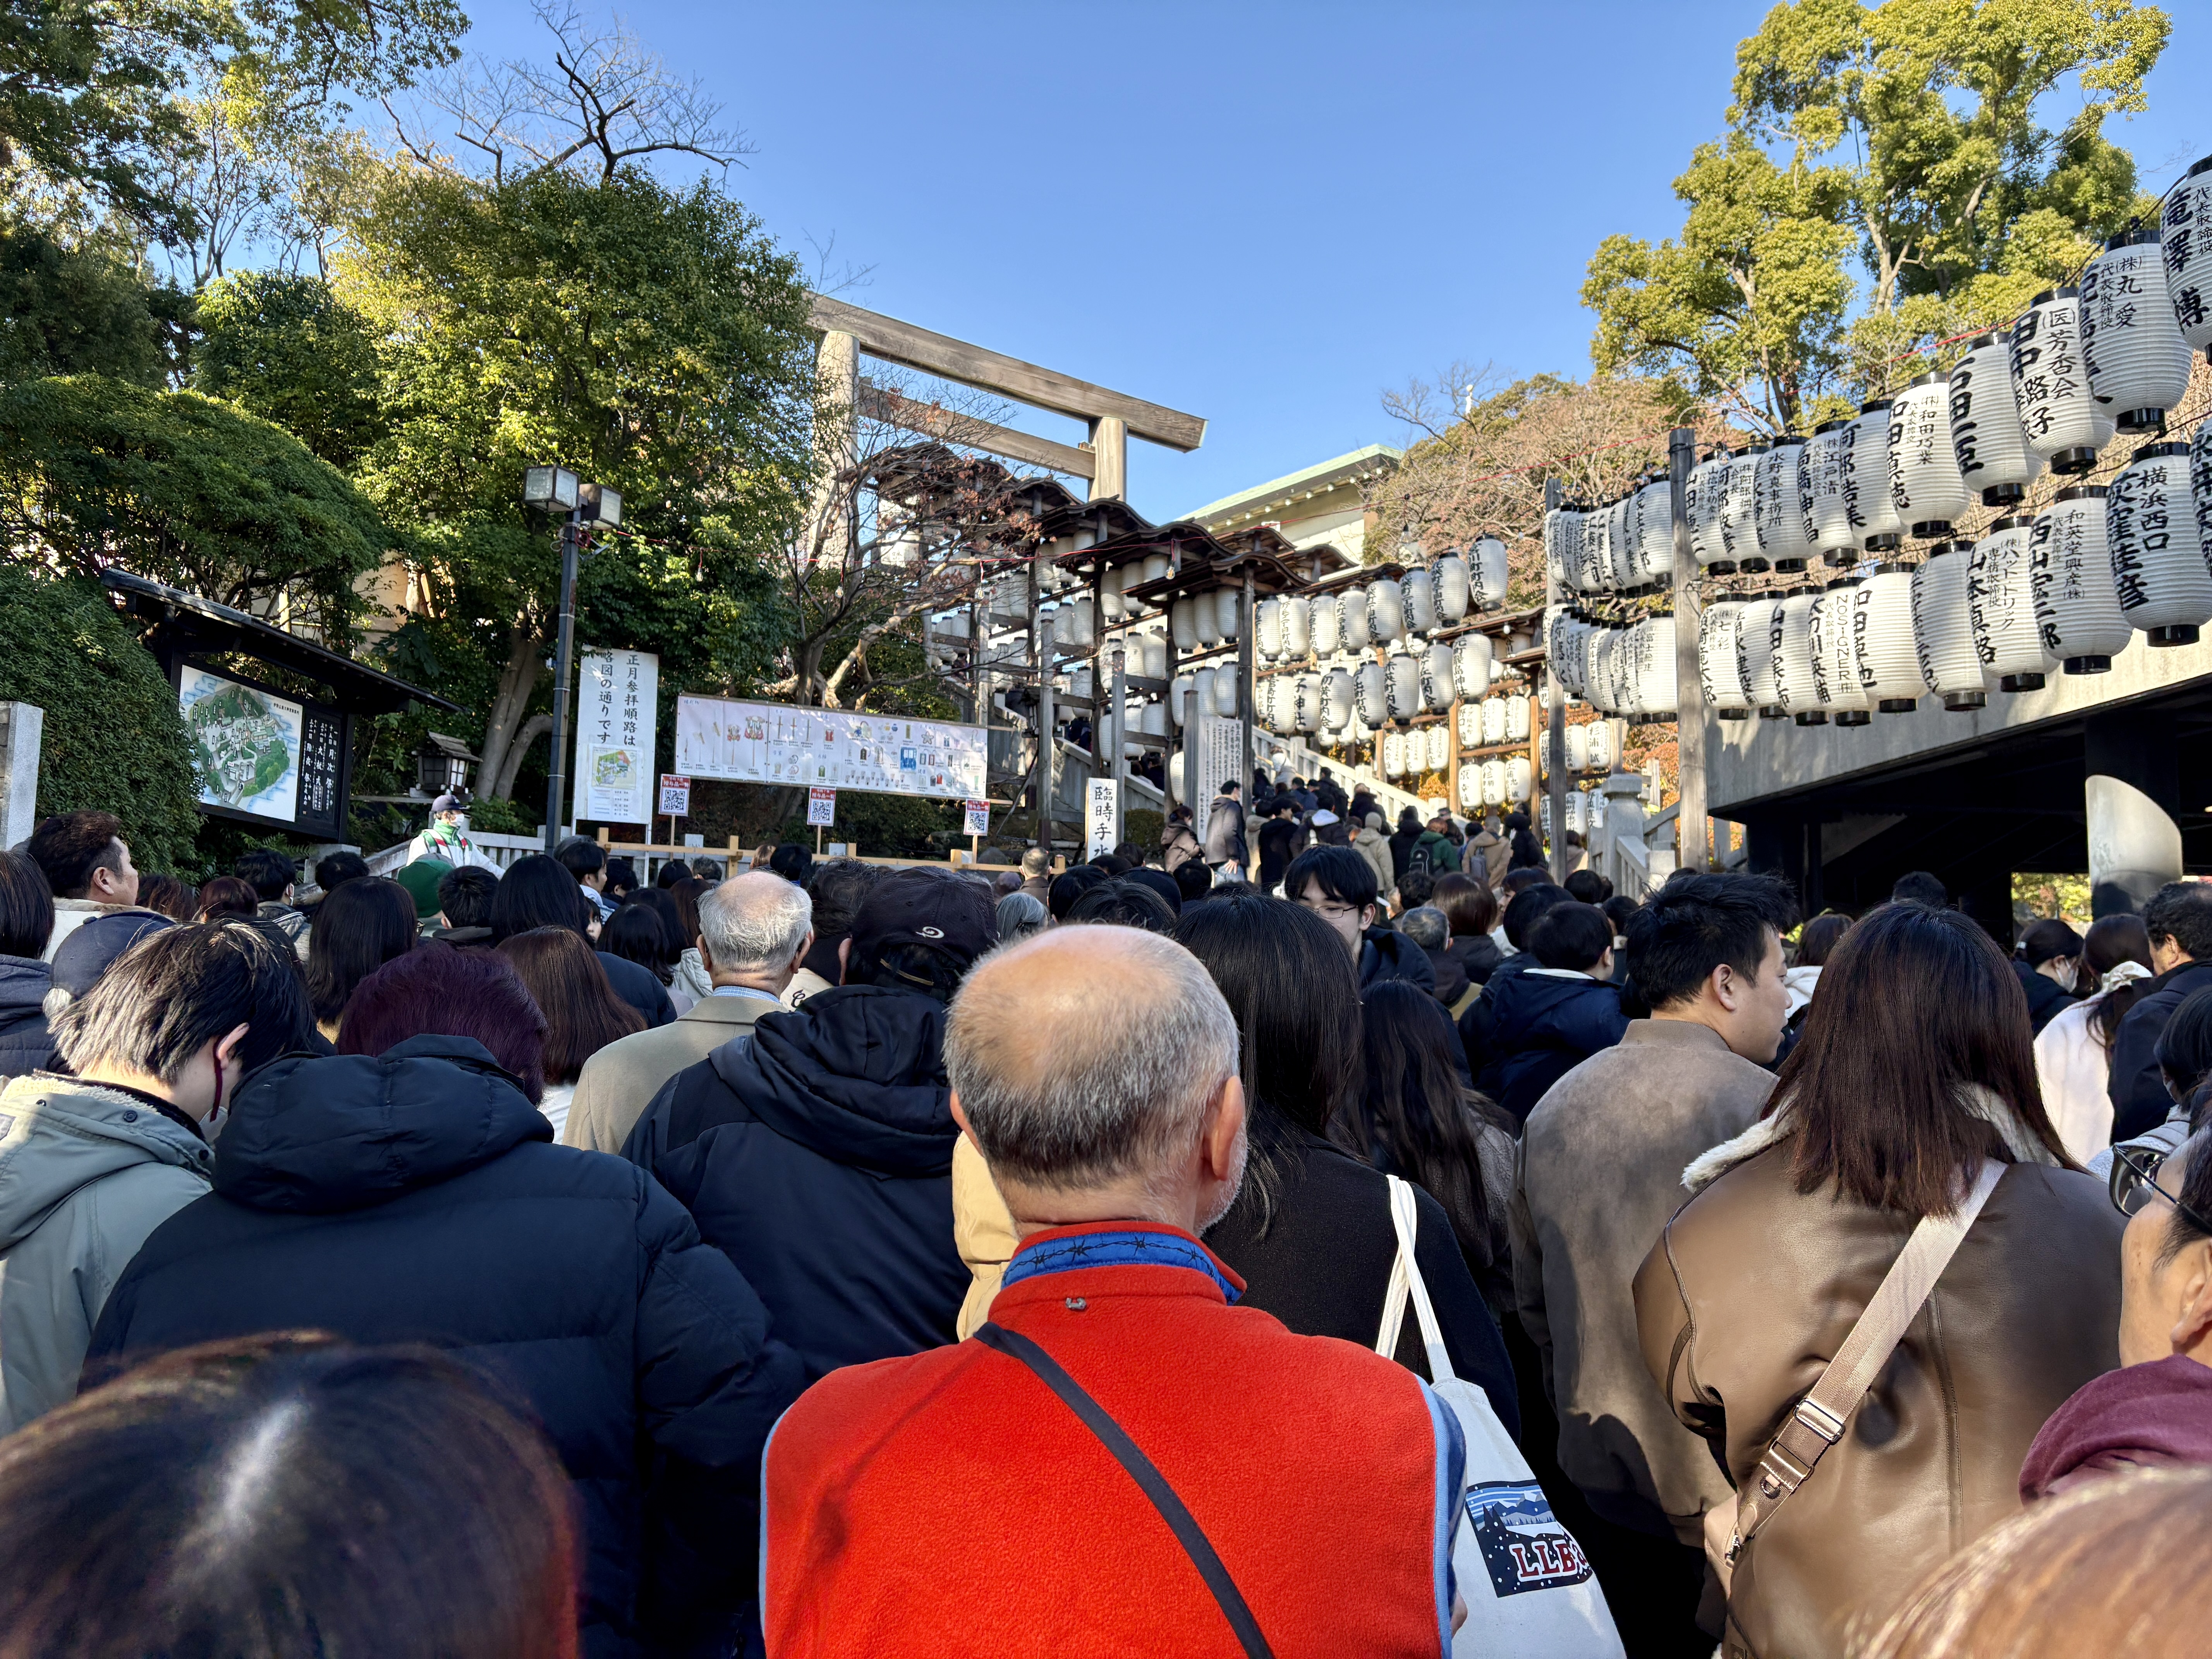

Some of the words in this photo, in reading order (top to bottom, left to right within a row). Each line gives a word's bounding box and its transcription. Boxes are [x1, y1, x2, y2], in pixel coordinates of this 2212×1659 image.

[2115, 256, 2143, 329] (株)丸愛
[2043, 308, 2079, 400] (医)芳香会
[2136, 466, 2170, 551] 横浜西口
[597, 651, 613, 744] 略図の通りです
[623, 654, 640, 746] 正月参拝順路は
